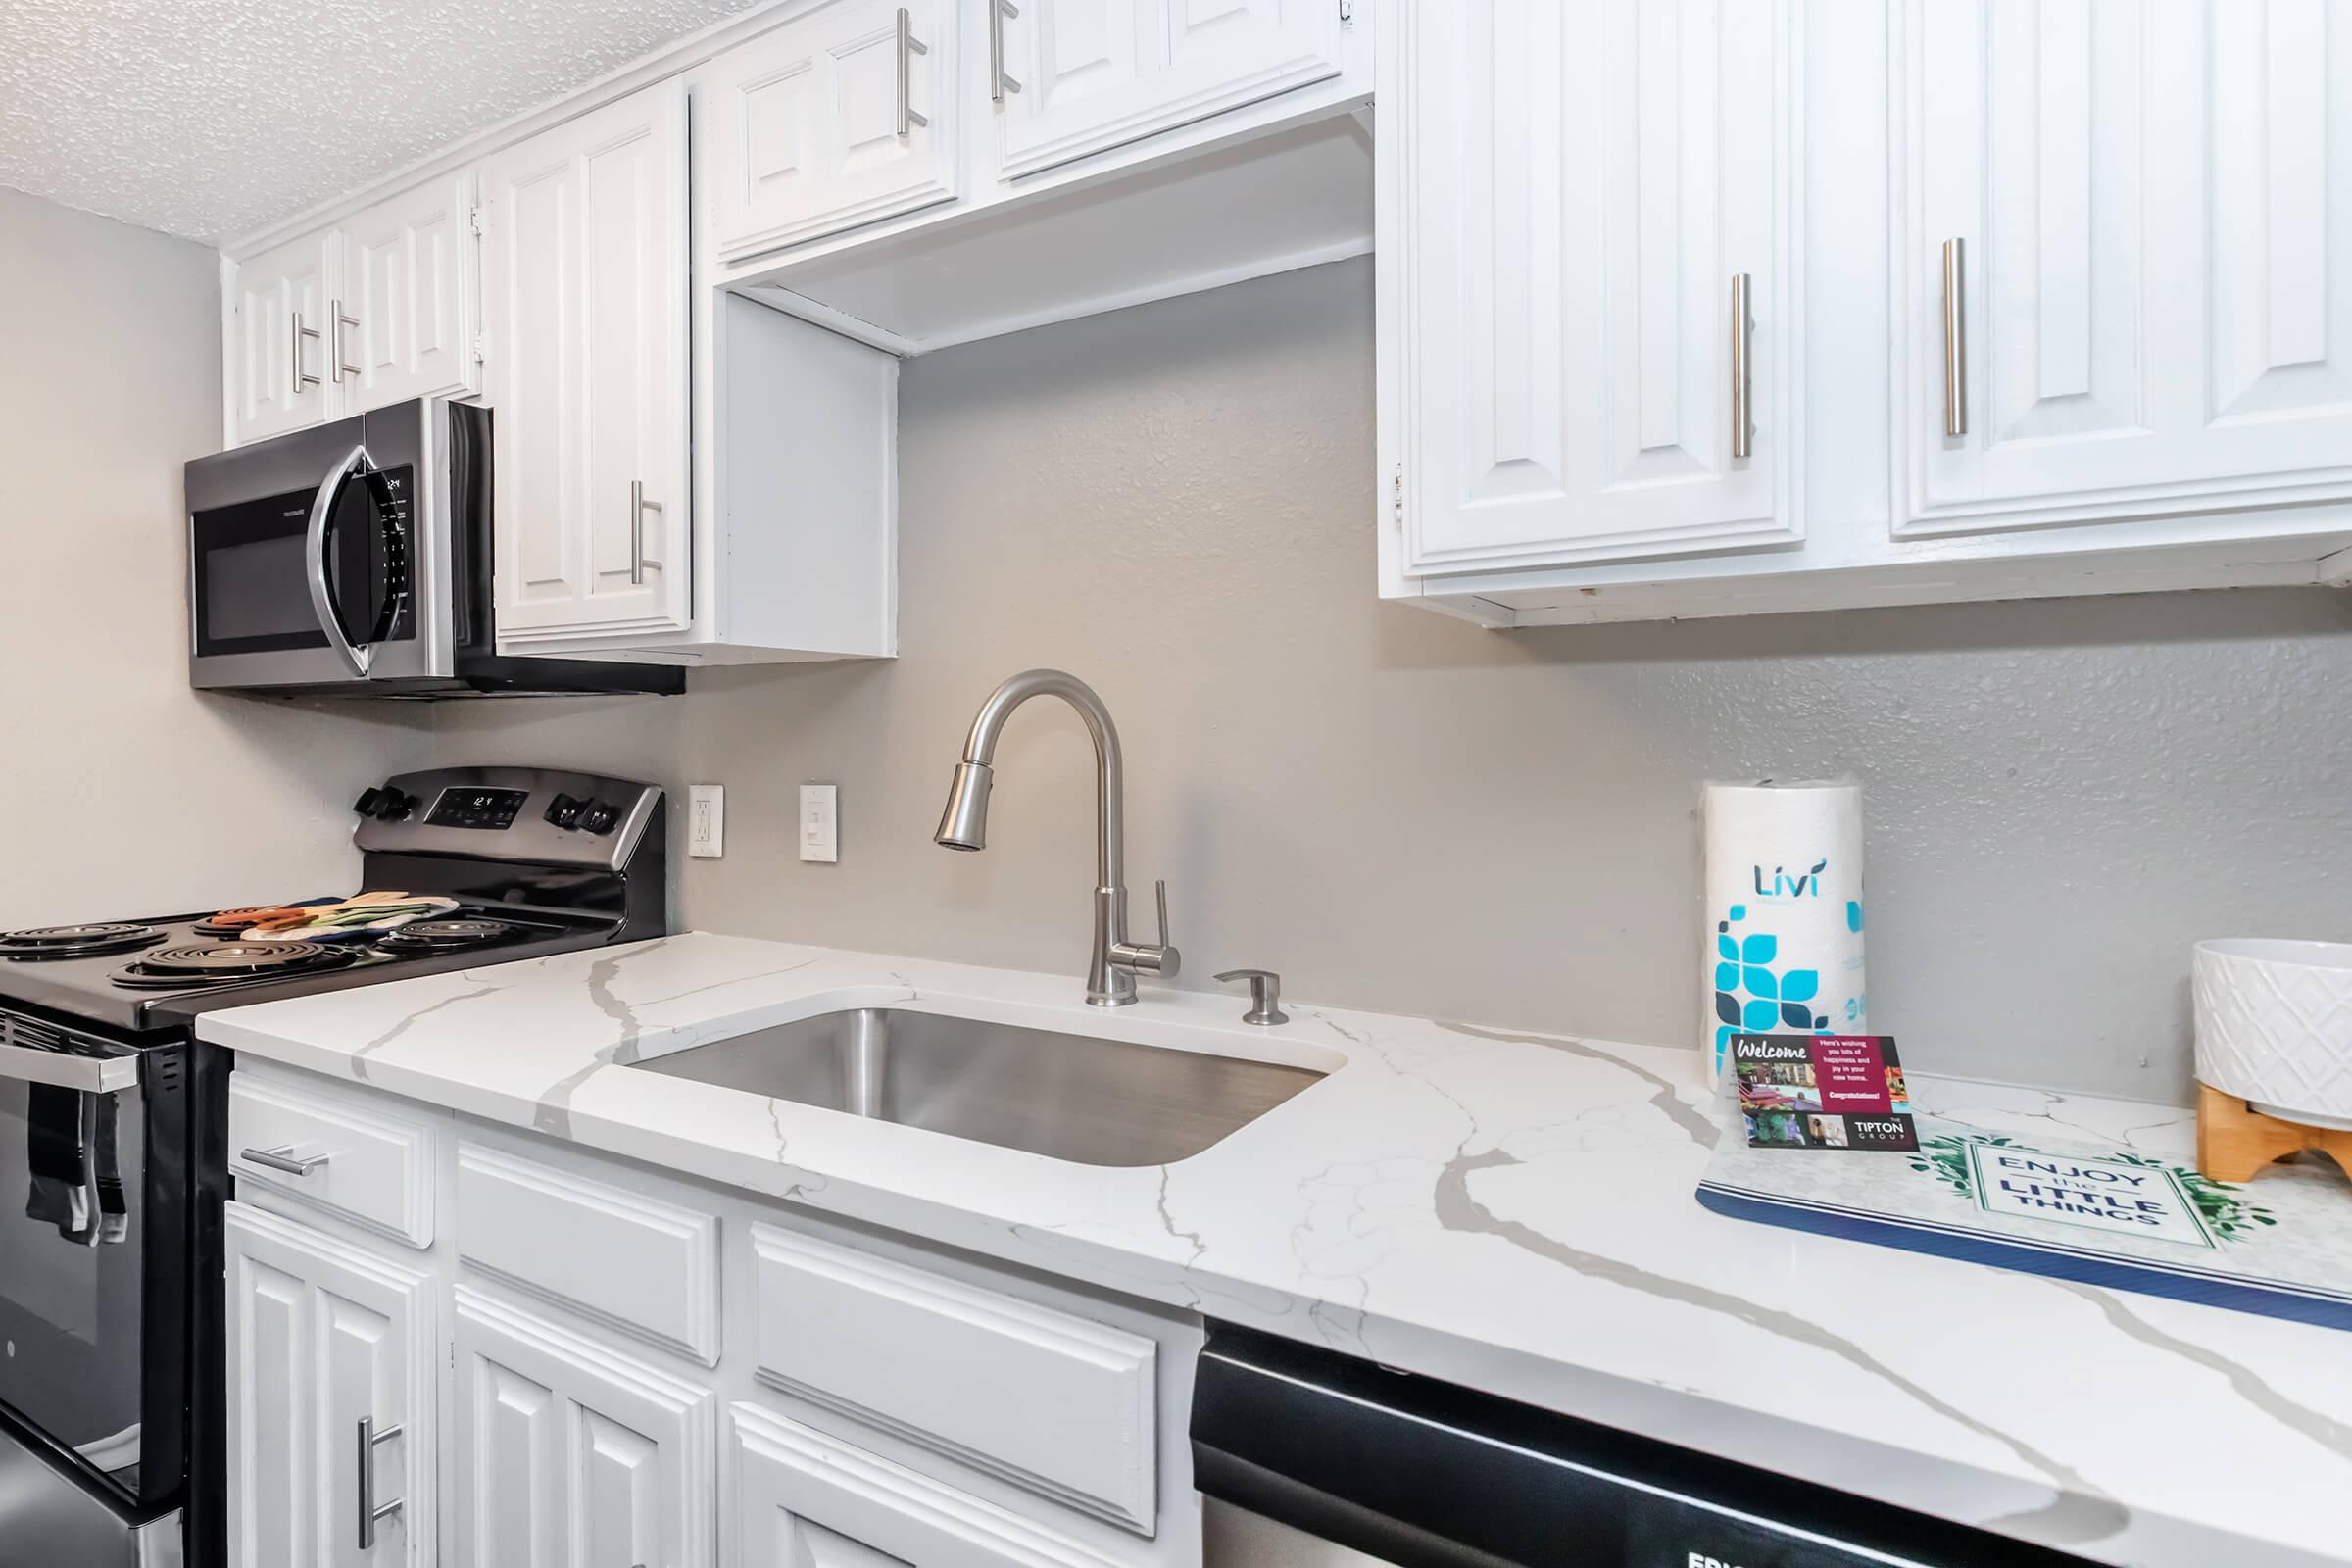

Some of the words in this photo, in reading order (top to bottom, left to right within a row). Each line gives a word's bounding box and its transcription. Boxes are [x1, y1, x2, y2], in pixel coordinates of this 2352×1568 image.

[1754, 858, 1827, 897] Livi
[1738, 1039, 1807, 1058] Welcome
[1854, 1121, 1905, 1134] TIPTON
[1858, 1132, 1906, 1141] GROUP
[1998, 1156, 2146, 1187] ENJOY
[2053, 1177, 2097, 1190] the
[1999, 1179, 2170, 1216] LITTLE
[2012, 1194, 2161, 1226] THINGS
